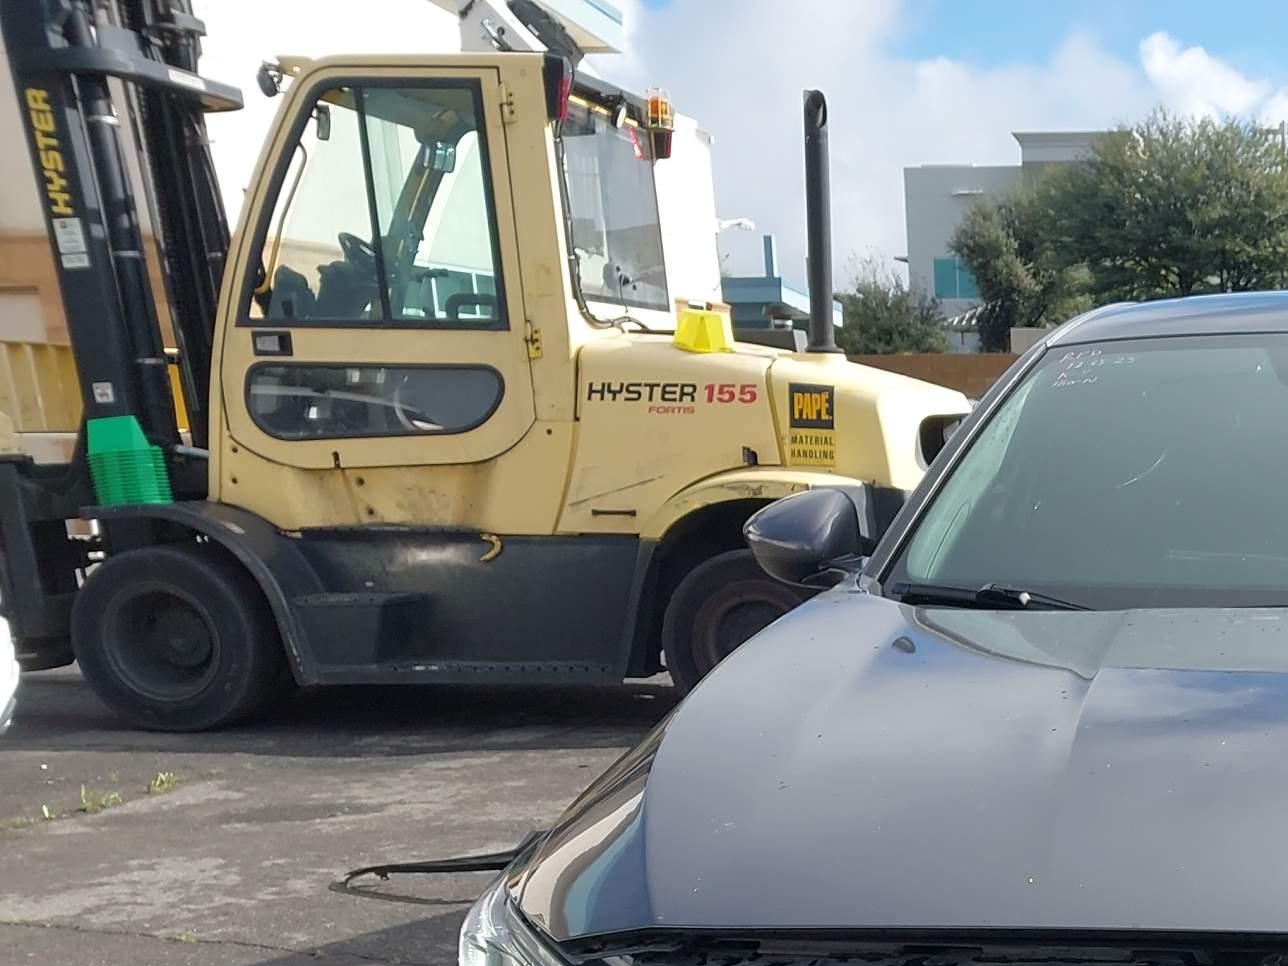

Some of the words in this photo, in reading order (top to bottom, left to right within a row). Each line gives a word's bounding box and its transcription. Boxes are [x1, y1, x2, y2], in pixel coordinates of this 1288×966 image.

[26, 88, 73, 215] HYSTER
[586, 382, 697, 402] HYSTER
[704, 384, 758, 403] 155
[648, 405, 695, 415] FORTIS
[791, 434, 835, 446] MATERIAL
[790, 447, 835, 460] HANDLING
